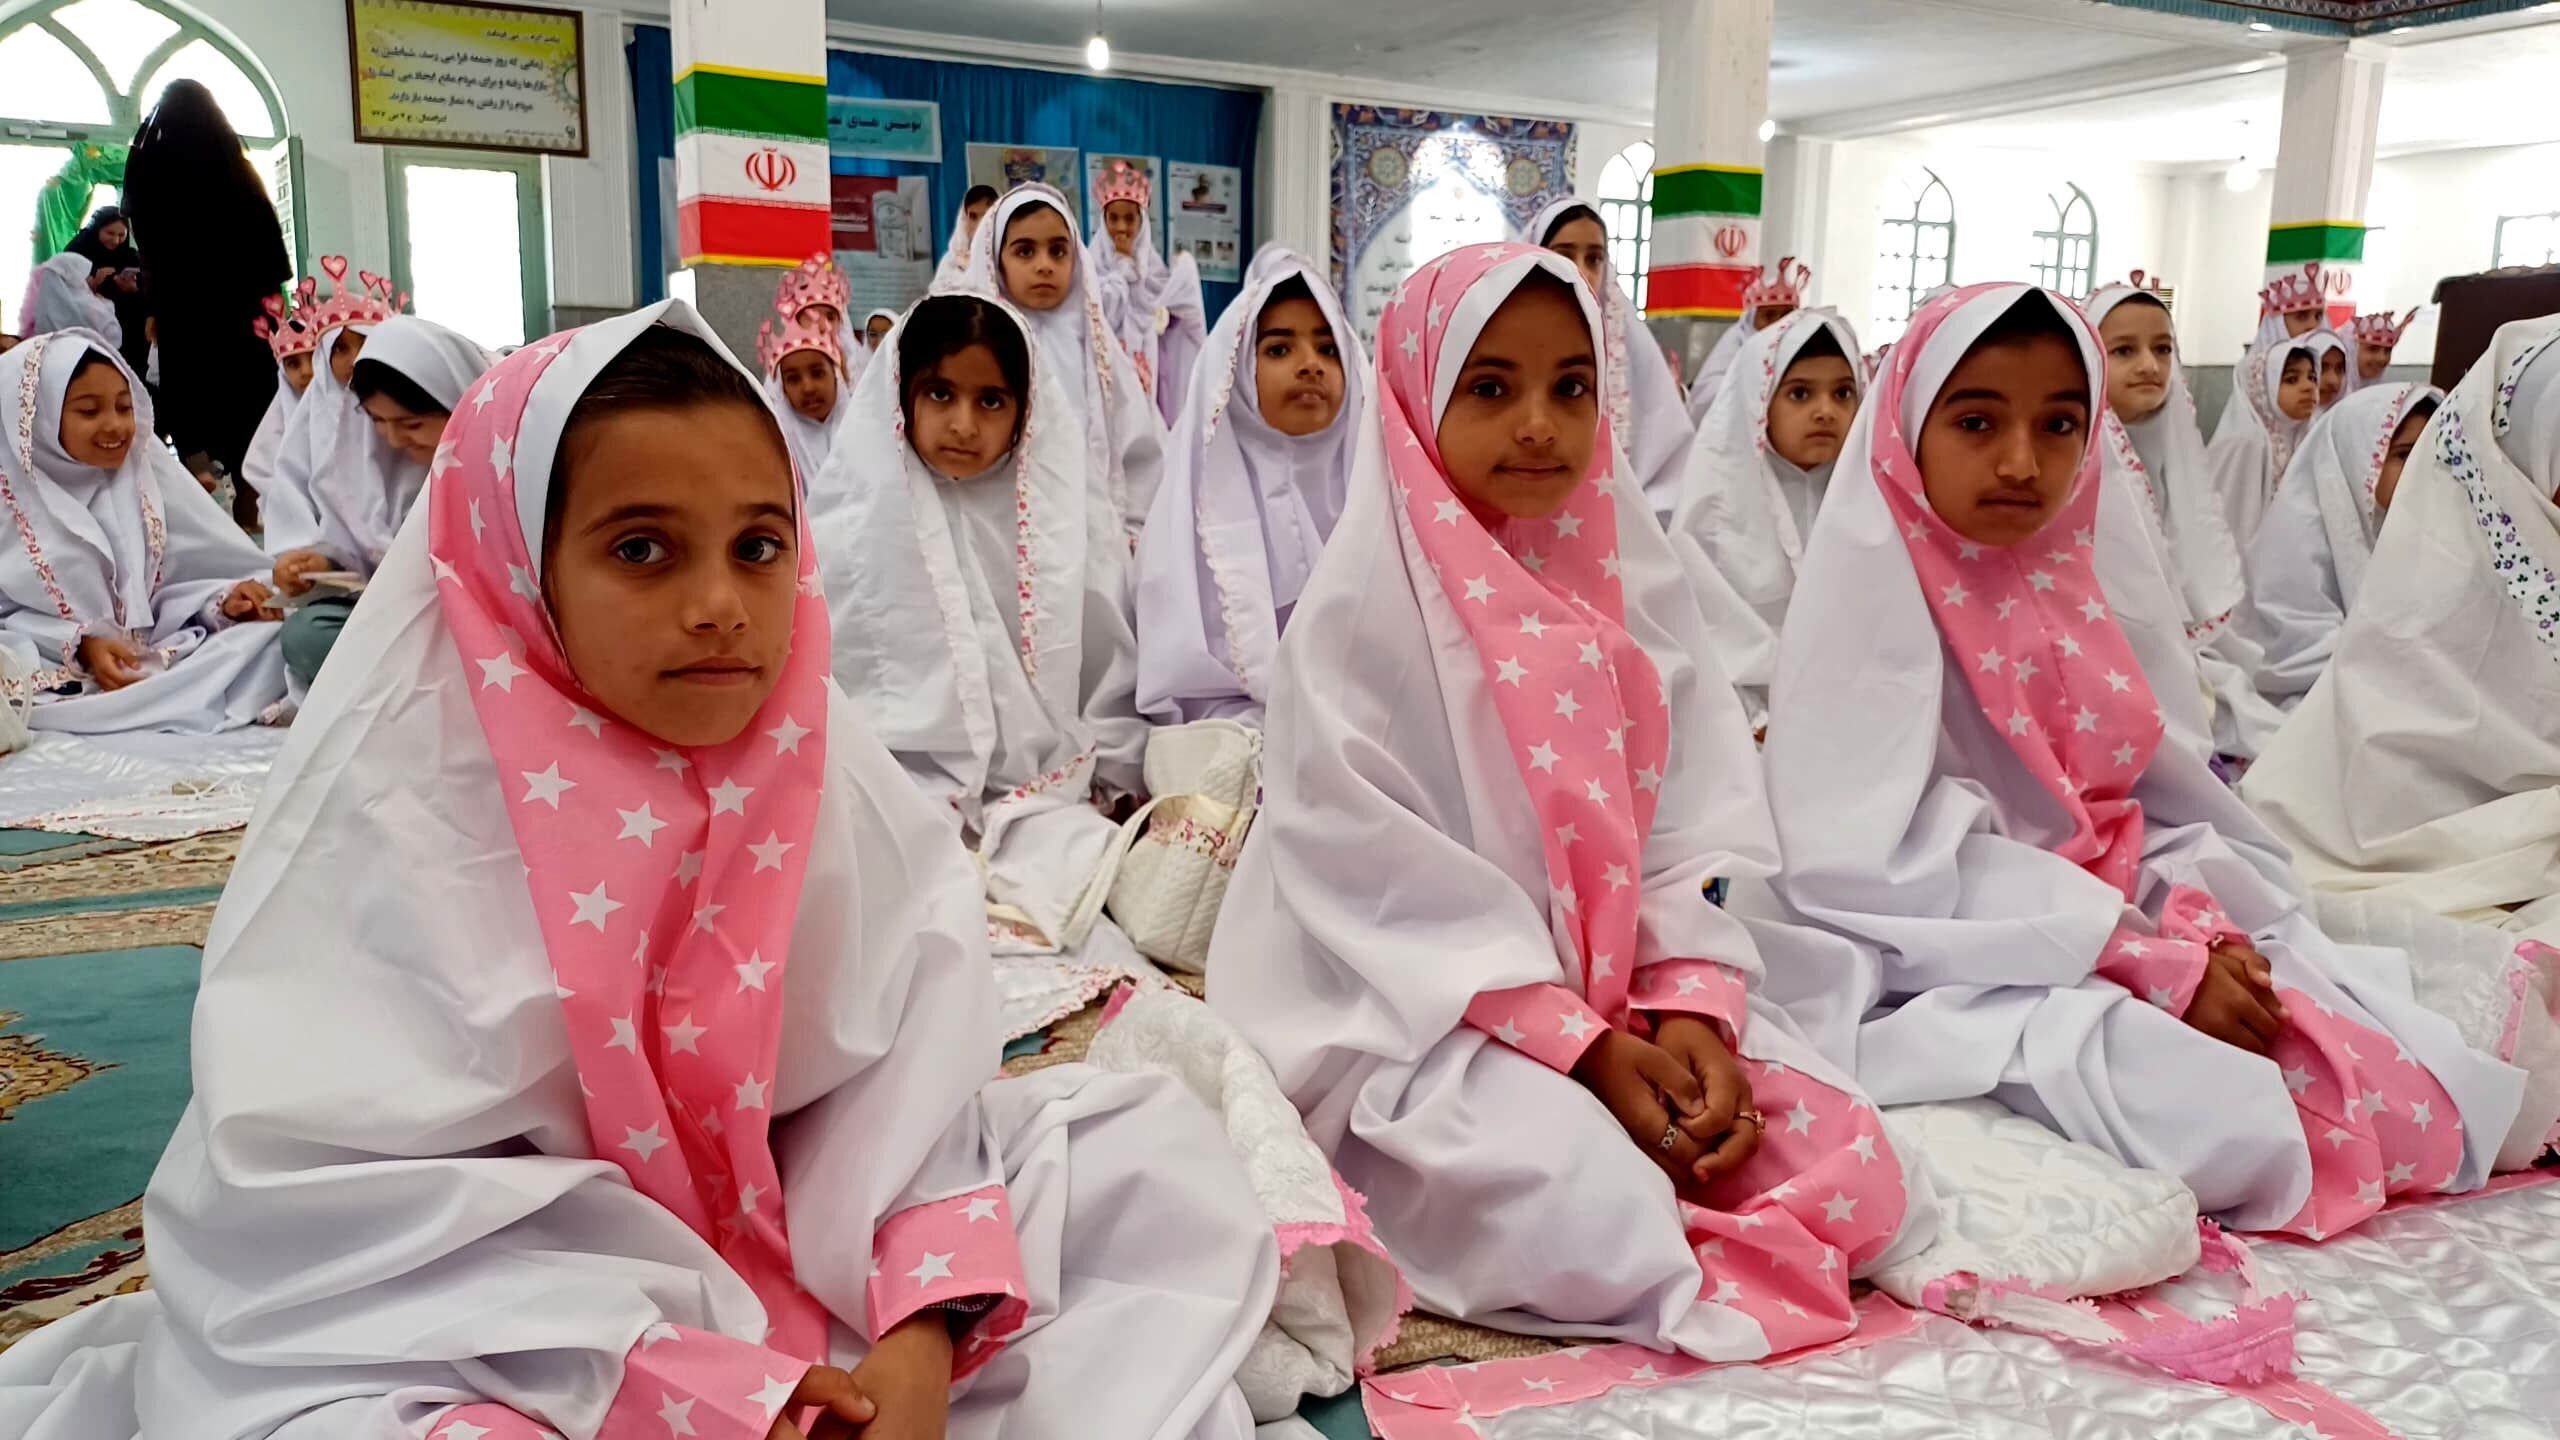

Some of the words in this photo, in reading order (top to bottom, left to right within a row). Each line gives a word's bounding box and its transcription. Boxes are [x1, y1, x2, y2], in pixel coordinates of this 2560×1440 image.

[371, 46, 379, 55] به
[440, 54, 456, 64] می
[456, 52, 468, 65] فرا
[470, 54, 492, 64] جمعه
[495, 56, 507, 68] روز
[509, 55, 518, 66] که
[520, 58, 544, 71] زمانی
[398, 73, 413, 82] می
[458, 76, 476, 87] مردم
[479, 75, 497, 89] برای
[498, 79, 504, 89] و
[411, 92, 422, 104] باز
[423, 95, 446, 103] جمعه
[448, 95, 465, 106] نماز
[467, 98, 475, 107] به
[476, 98, 497, 110] رفتن
[498, 99, 505, 111] از
[506, 99, 513, 110] را
[515, 101, 533, 113] مردم
